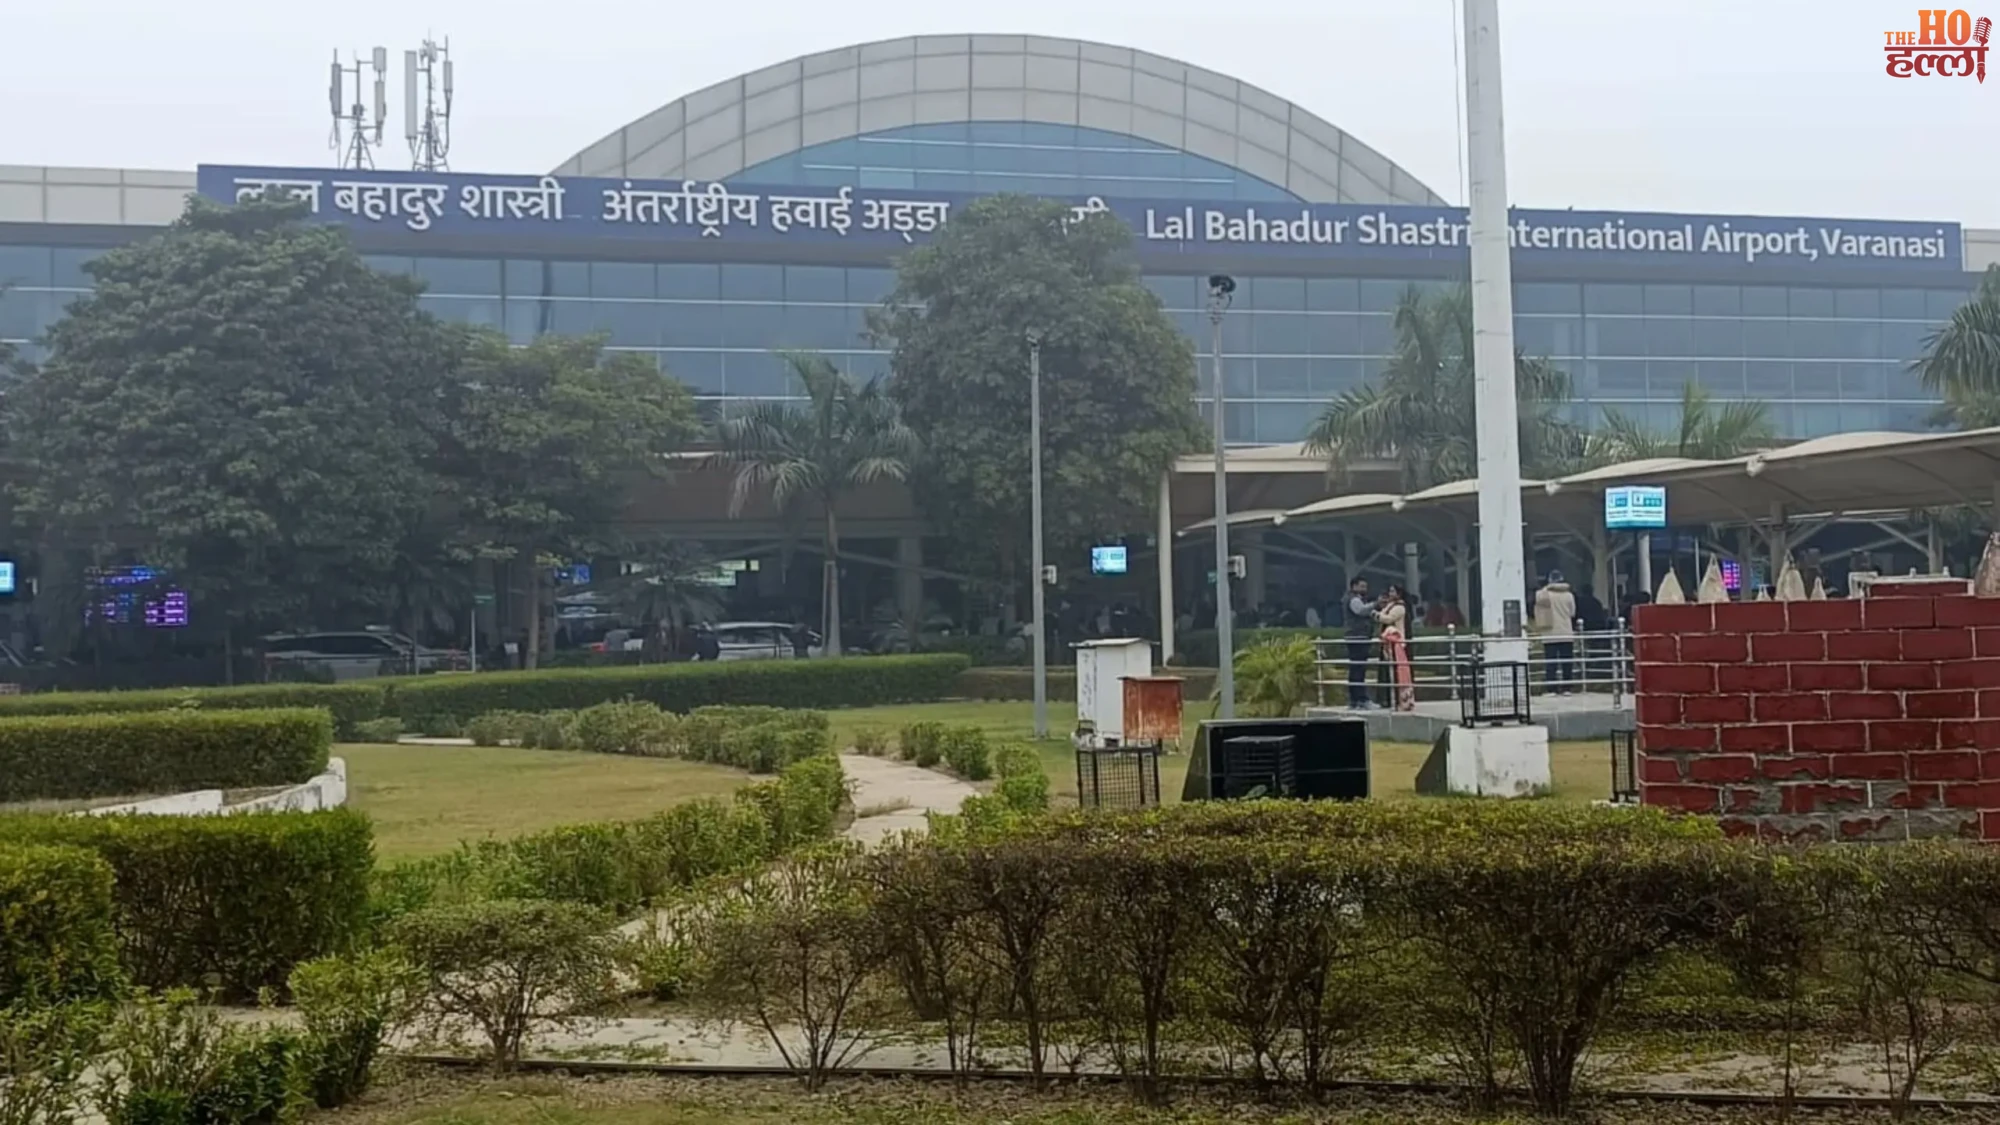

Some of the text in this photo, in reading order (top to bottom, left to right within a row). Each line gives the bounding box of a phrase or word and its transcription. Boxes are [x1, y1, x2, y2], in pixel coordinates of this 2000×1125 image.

[331, 180, 449, 231] बहादुर
[460, 177, 566, 222] शास्त्री
[602, 180, 760, 237] अंतर्राष्ट्रीय
[769, 186, 854, 235] हवाई
[1146, 206, 1194, 241] Lal
[1205, 210, 1349, 244] Bahadur
[1507, 219, 1693, 253] nternational
[1701, 223, 1819, 262] Airport,
[1820, 227, 1945, 259] Varanasi
